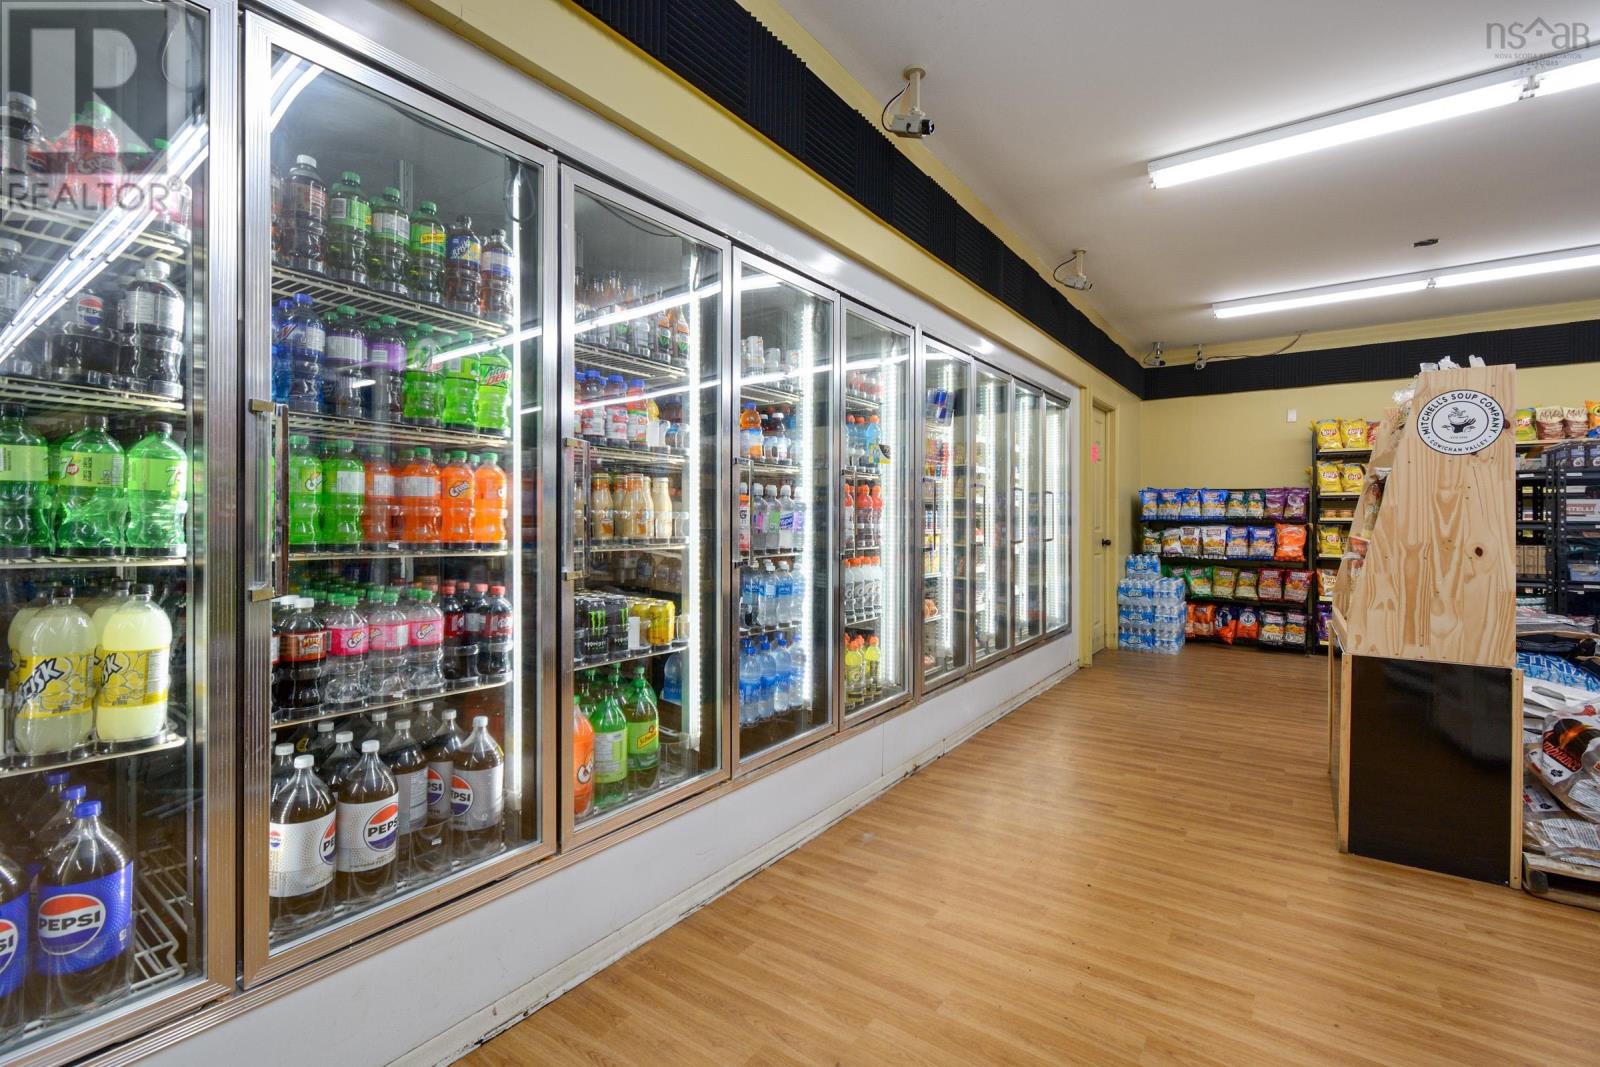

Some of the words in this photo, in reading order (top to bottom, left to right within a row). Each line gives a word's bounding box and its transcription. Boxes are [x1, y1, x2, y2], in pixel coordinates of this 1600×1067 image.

[1420, 396, 1449, 436] MITCHELL'S
[1451, 392, 1478, 401] SOUP
[1479, 397, 1501, 434] COMPANY
[1429, 440, 1463, 453] COWICHAN
[1465, 438, 1488, 451] VALLEY
[38, 909, 101, 932] PEPSI
